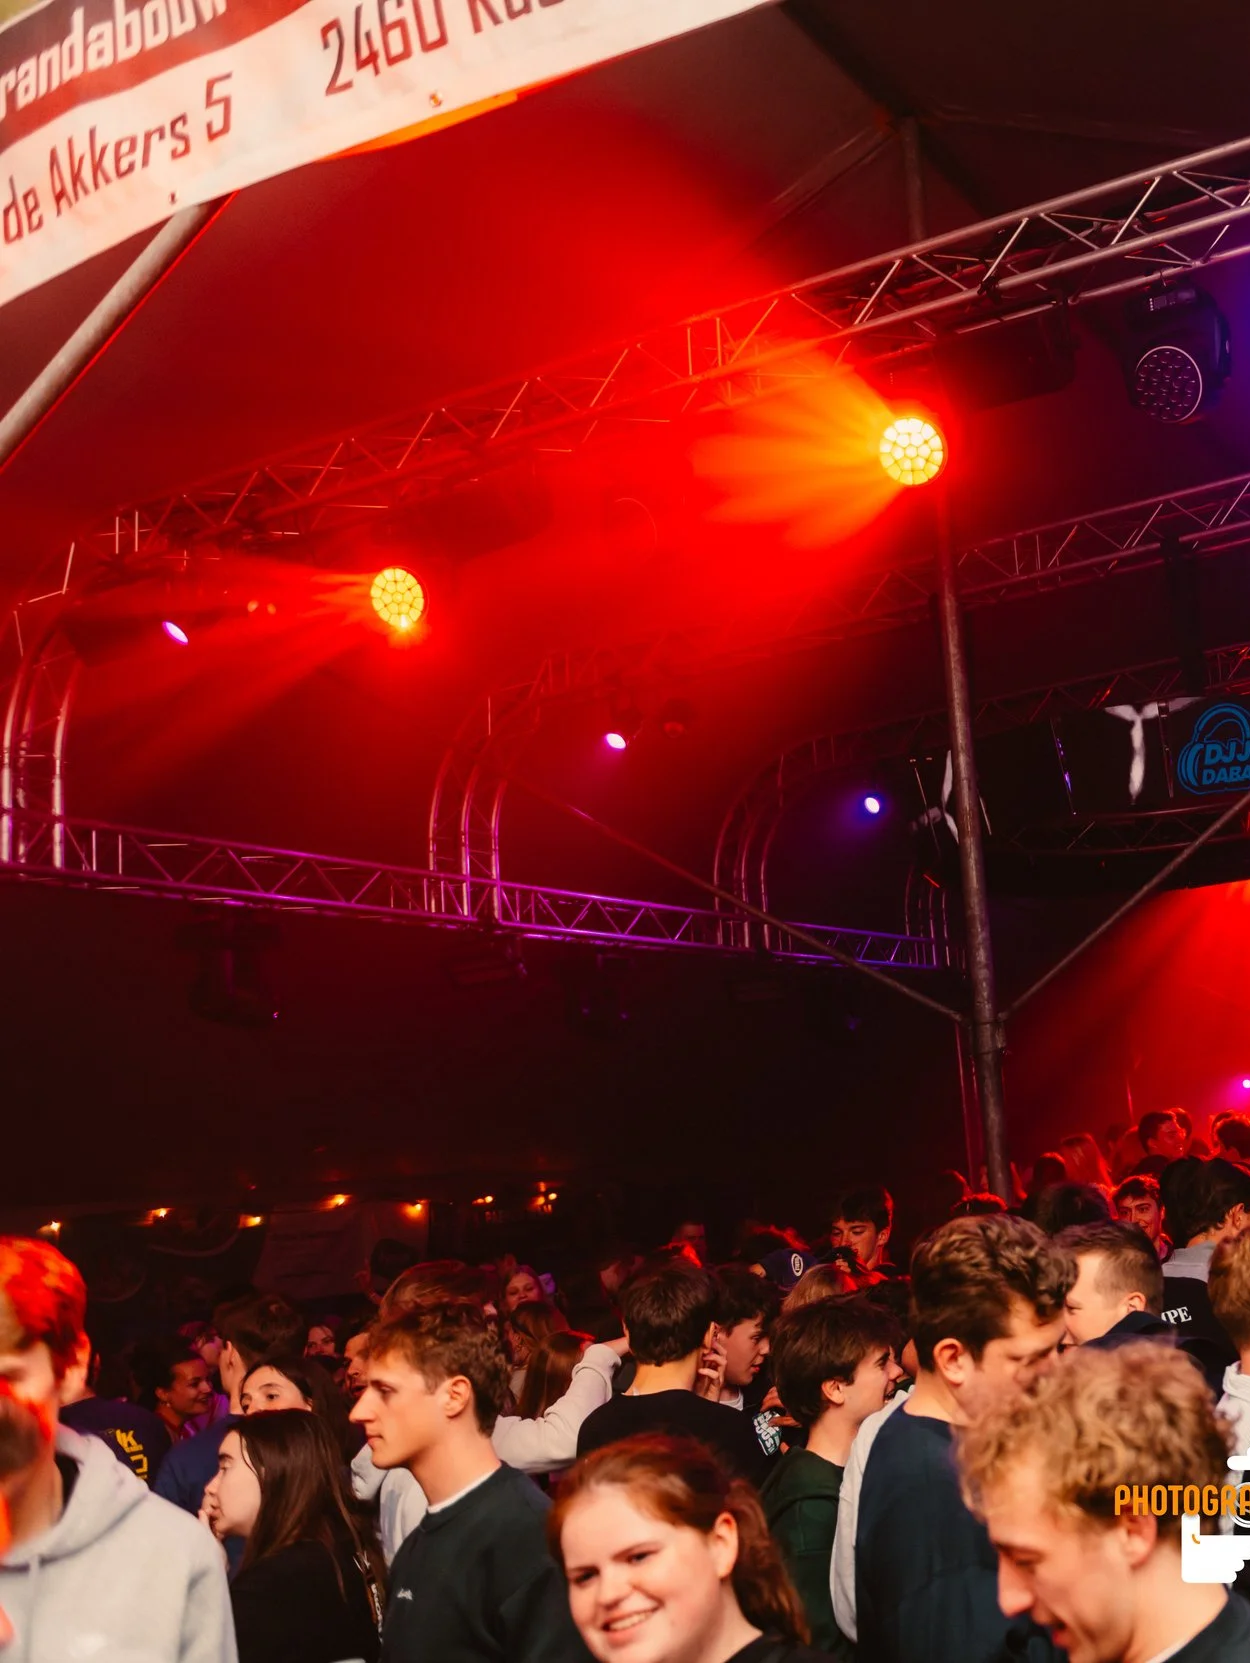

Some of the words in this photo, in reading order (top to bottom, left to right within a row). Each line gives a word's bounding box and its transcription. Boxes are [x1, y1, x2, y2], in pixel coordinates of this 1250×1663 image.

[3, 174, 43, 245] de
[49, 112, 191, 217] Akkers
[205, 71, 233, 142] 5
[319, 0, 449, 97] 2460
[1203, 741, 1237, 766] DJ
